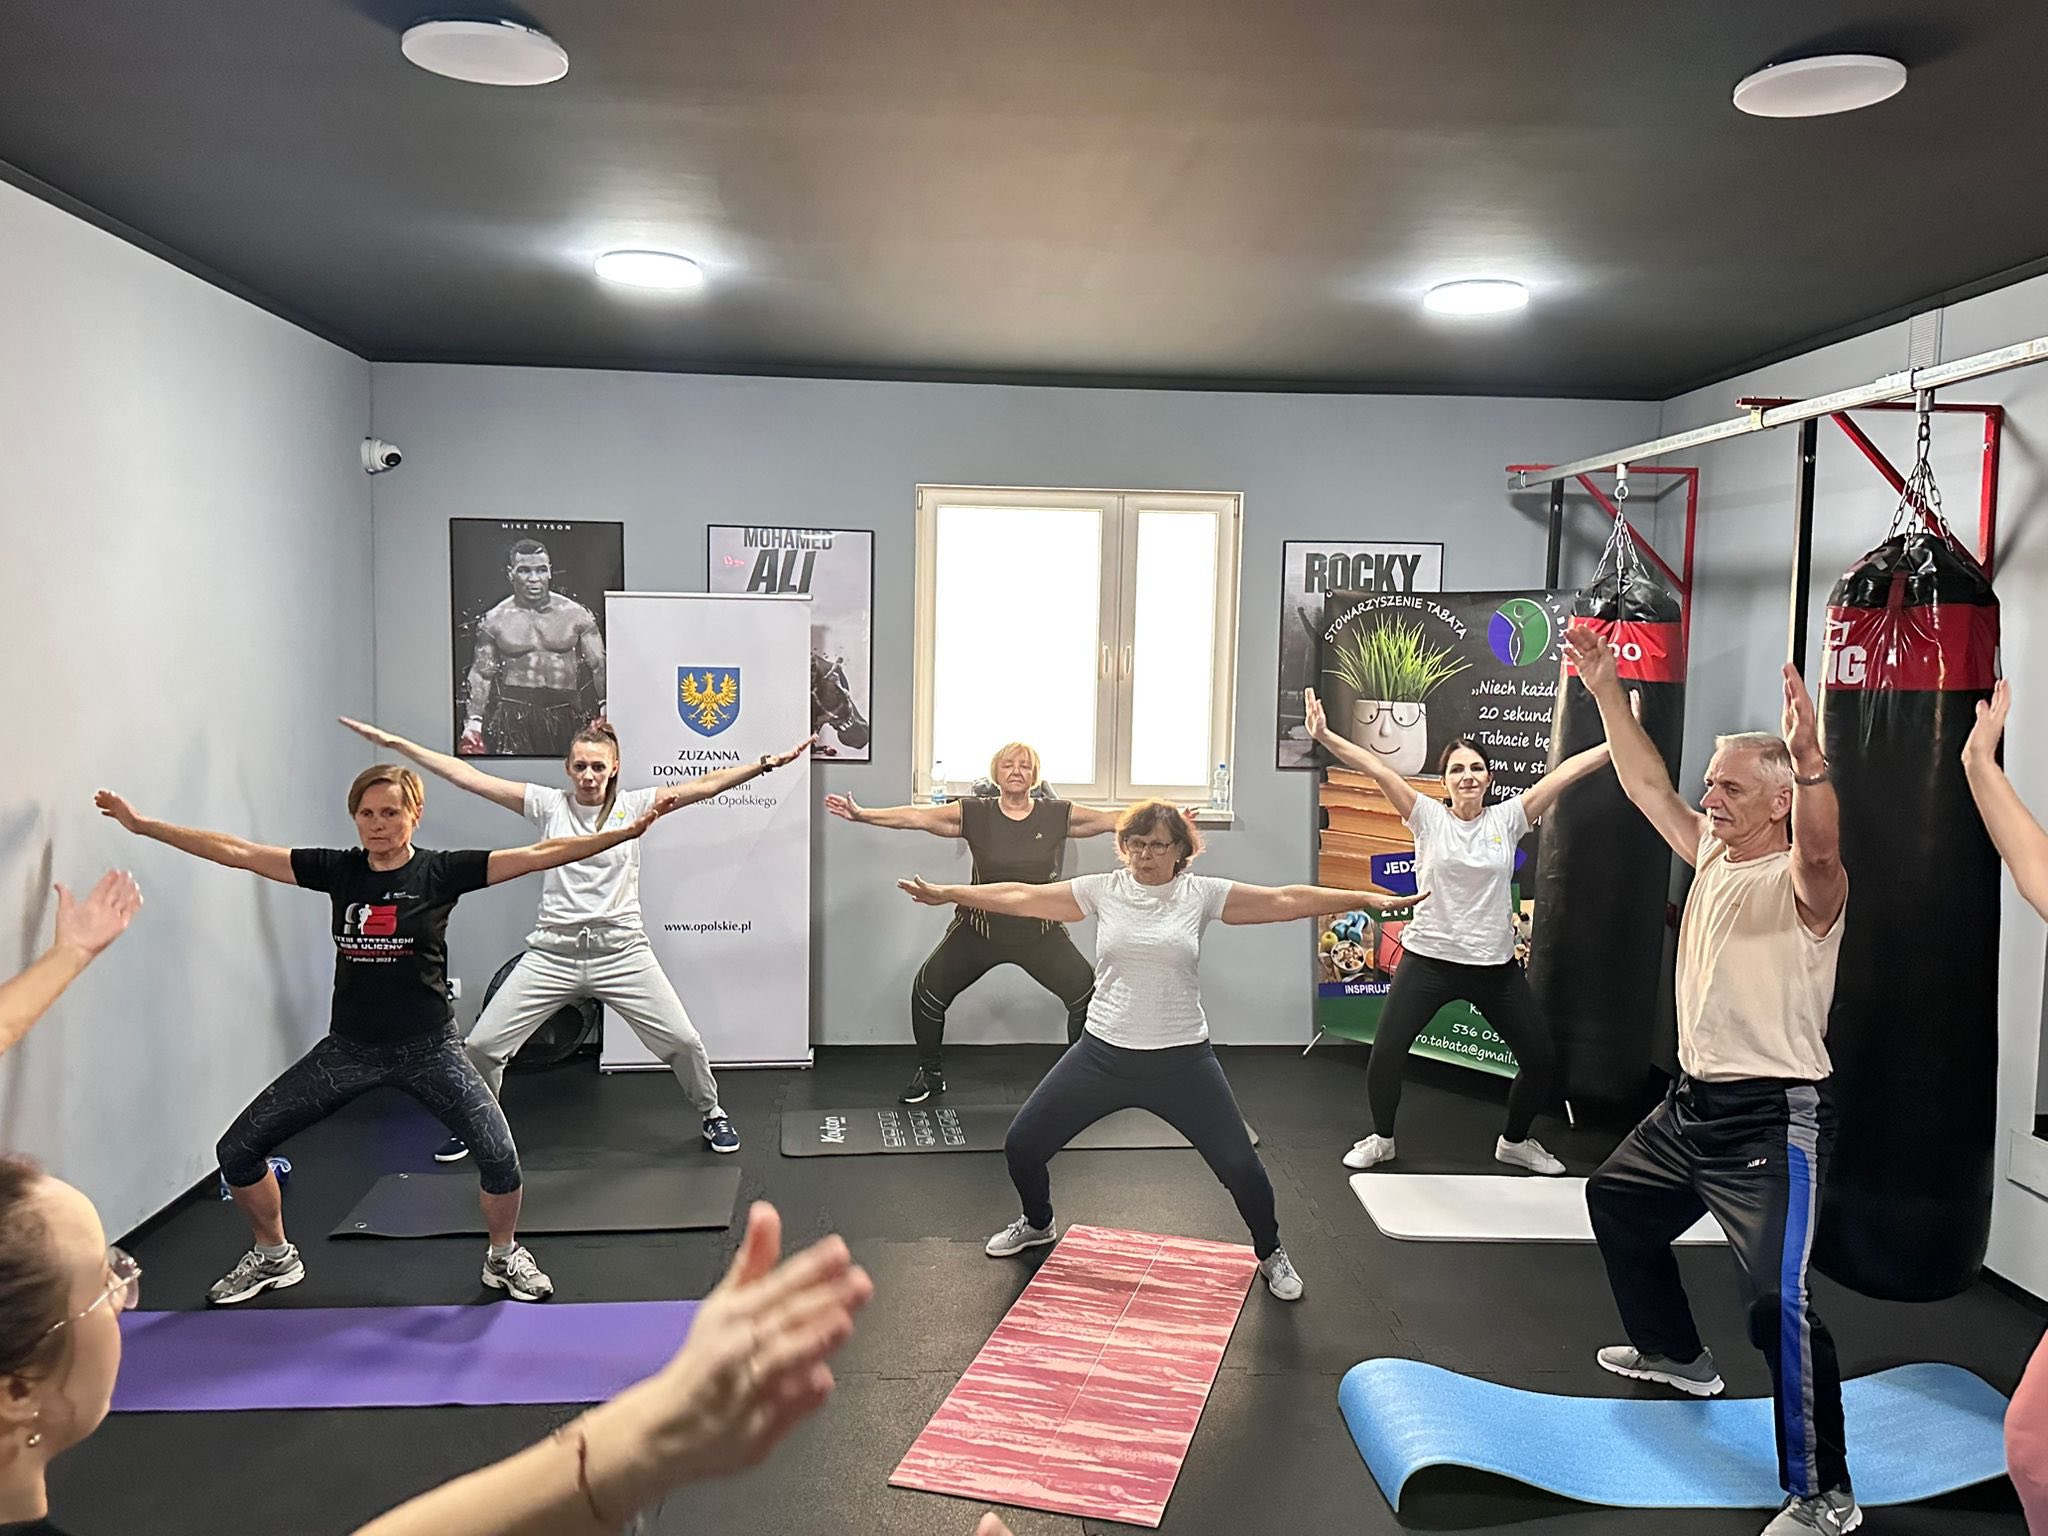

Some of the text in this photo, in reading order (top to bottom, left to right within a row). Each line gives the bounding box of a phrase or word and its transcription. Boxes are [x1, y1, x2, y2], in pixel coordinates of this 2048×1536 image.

[536, 523, 571, 531] TYSON
[743, 527, 833, 550] MOHAMED
[746, 548, 817, 594] ALI
[1304, 552, 1422, 593] ROCKY
[1324, 595, 1469, 643] STOWARZYSZENIE TABATA
[1478, 706, 1552, 723] 20 sekund
[1480, 729, 1530, 747] Tabacie
[678, 750, 740, 761] ZUZANNA
[1513, 760, 1527, 772] w
[718, 795, 777, 809] Opolskiego
[664, 921, 752, 934] www.opolskie.pl
[1452, 1023, 1478, 1037] 536
